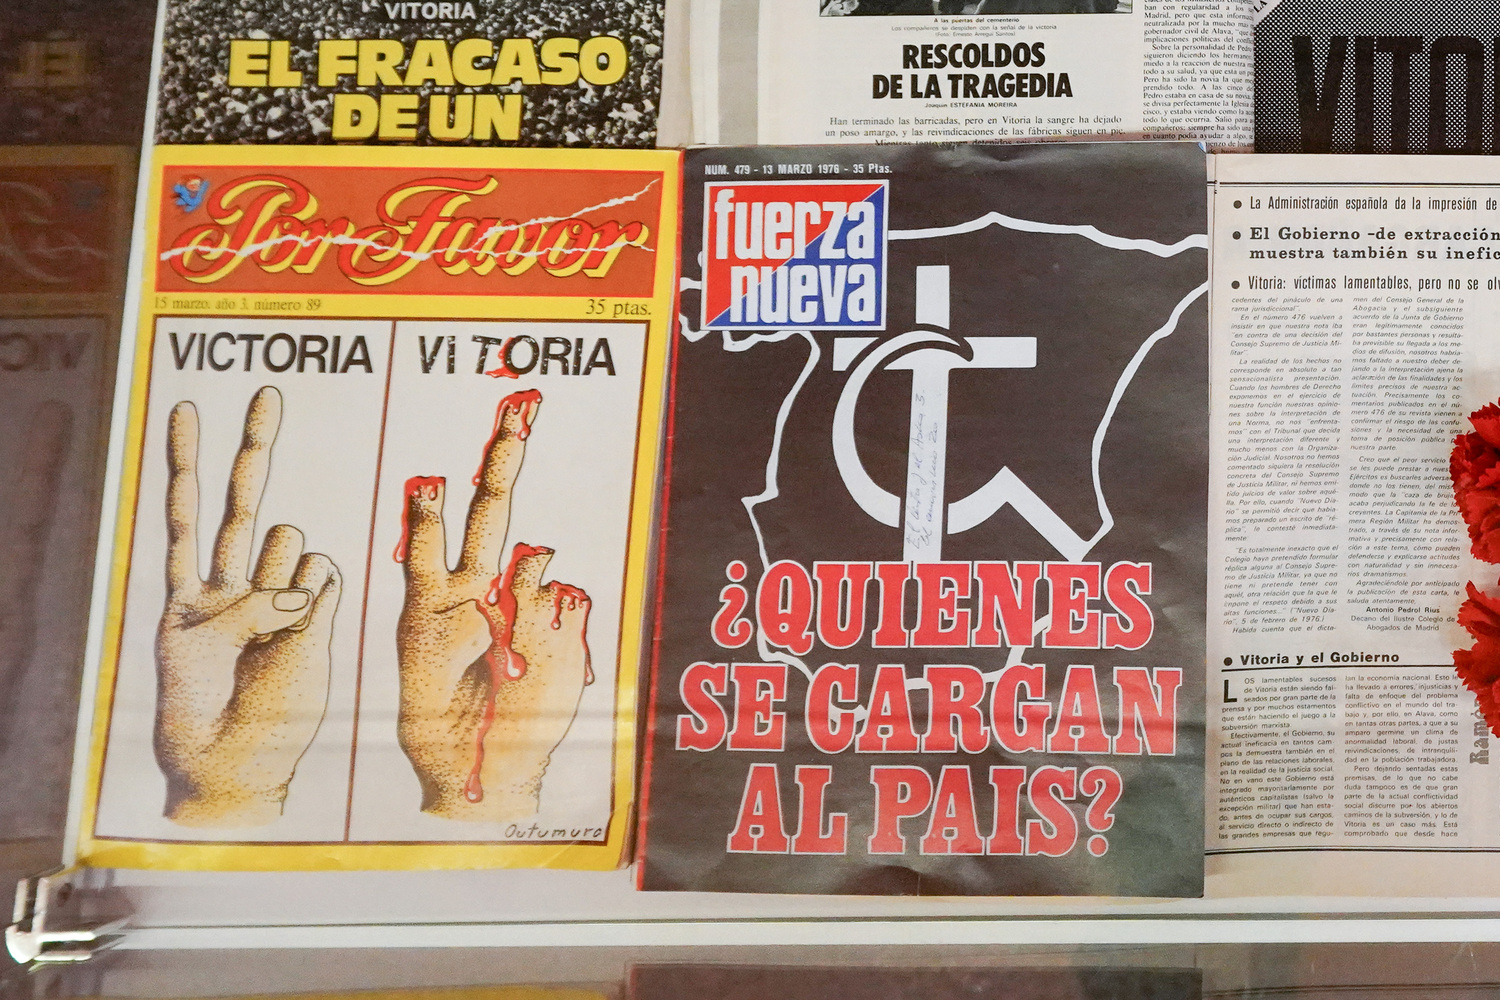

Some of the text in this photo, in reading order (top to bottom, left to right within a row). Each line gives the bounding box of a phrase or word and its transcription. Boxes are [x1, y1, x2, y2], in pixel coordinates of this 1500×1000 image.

[385, 2, 476, 20] VITORIA
[1253, 0, 1268, 13] LA
[229, 37, 628, 87] EL FRACASO
[902, 42, 1046, 69] RESCOLDOS
[872, 73, 1073, 99] DE LA TRAGEDIA
[333, 94, 522, 140] DE UN
[704, 163, 893, 175] NUM. 479 13 MARZO 1976 35 Ptas.
[1250, 197, 1260, 209] La
[1268, 196, 1338, 210] Administración
[1346, 197, 1388, 211] española
[1395, 197, 1406, 210] da
[1412, 197, 1421, 210] la
[1428, 198, 1477, 212] impresión
[1486, 198, 1497, 211] de
[168, 174, 649, 287] Por Favor
[715, 189, 876, 260] fuerza
[1249, 227, 1269, 240] El
[1278, 227, 1360, 241] Gobierno
[1404, 228, 1500, 242] extracción
[1249, 248, 1325, 260] muestra
[1333, 246, 1408, 260] también
[1416, 250, 1437, 260] su
[730, 263, 877, 324] nueva
[585, 298, 652, 319] 35 ptas.
[169, 332, 373, 374] VICTORIA
[712, 560, 1154, 655] ¿QUIENES
[1240, 652, 1400, 666] Vitoria y el Gobierno
[676, 662, 1183, 756] SE CARGAN
[726, 764, 1123, 857] AL PAIS?
